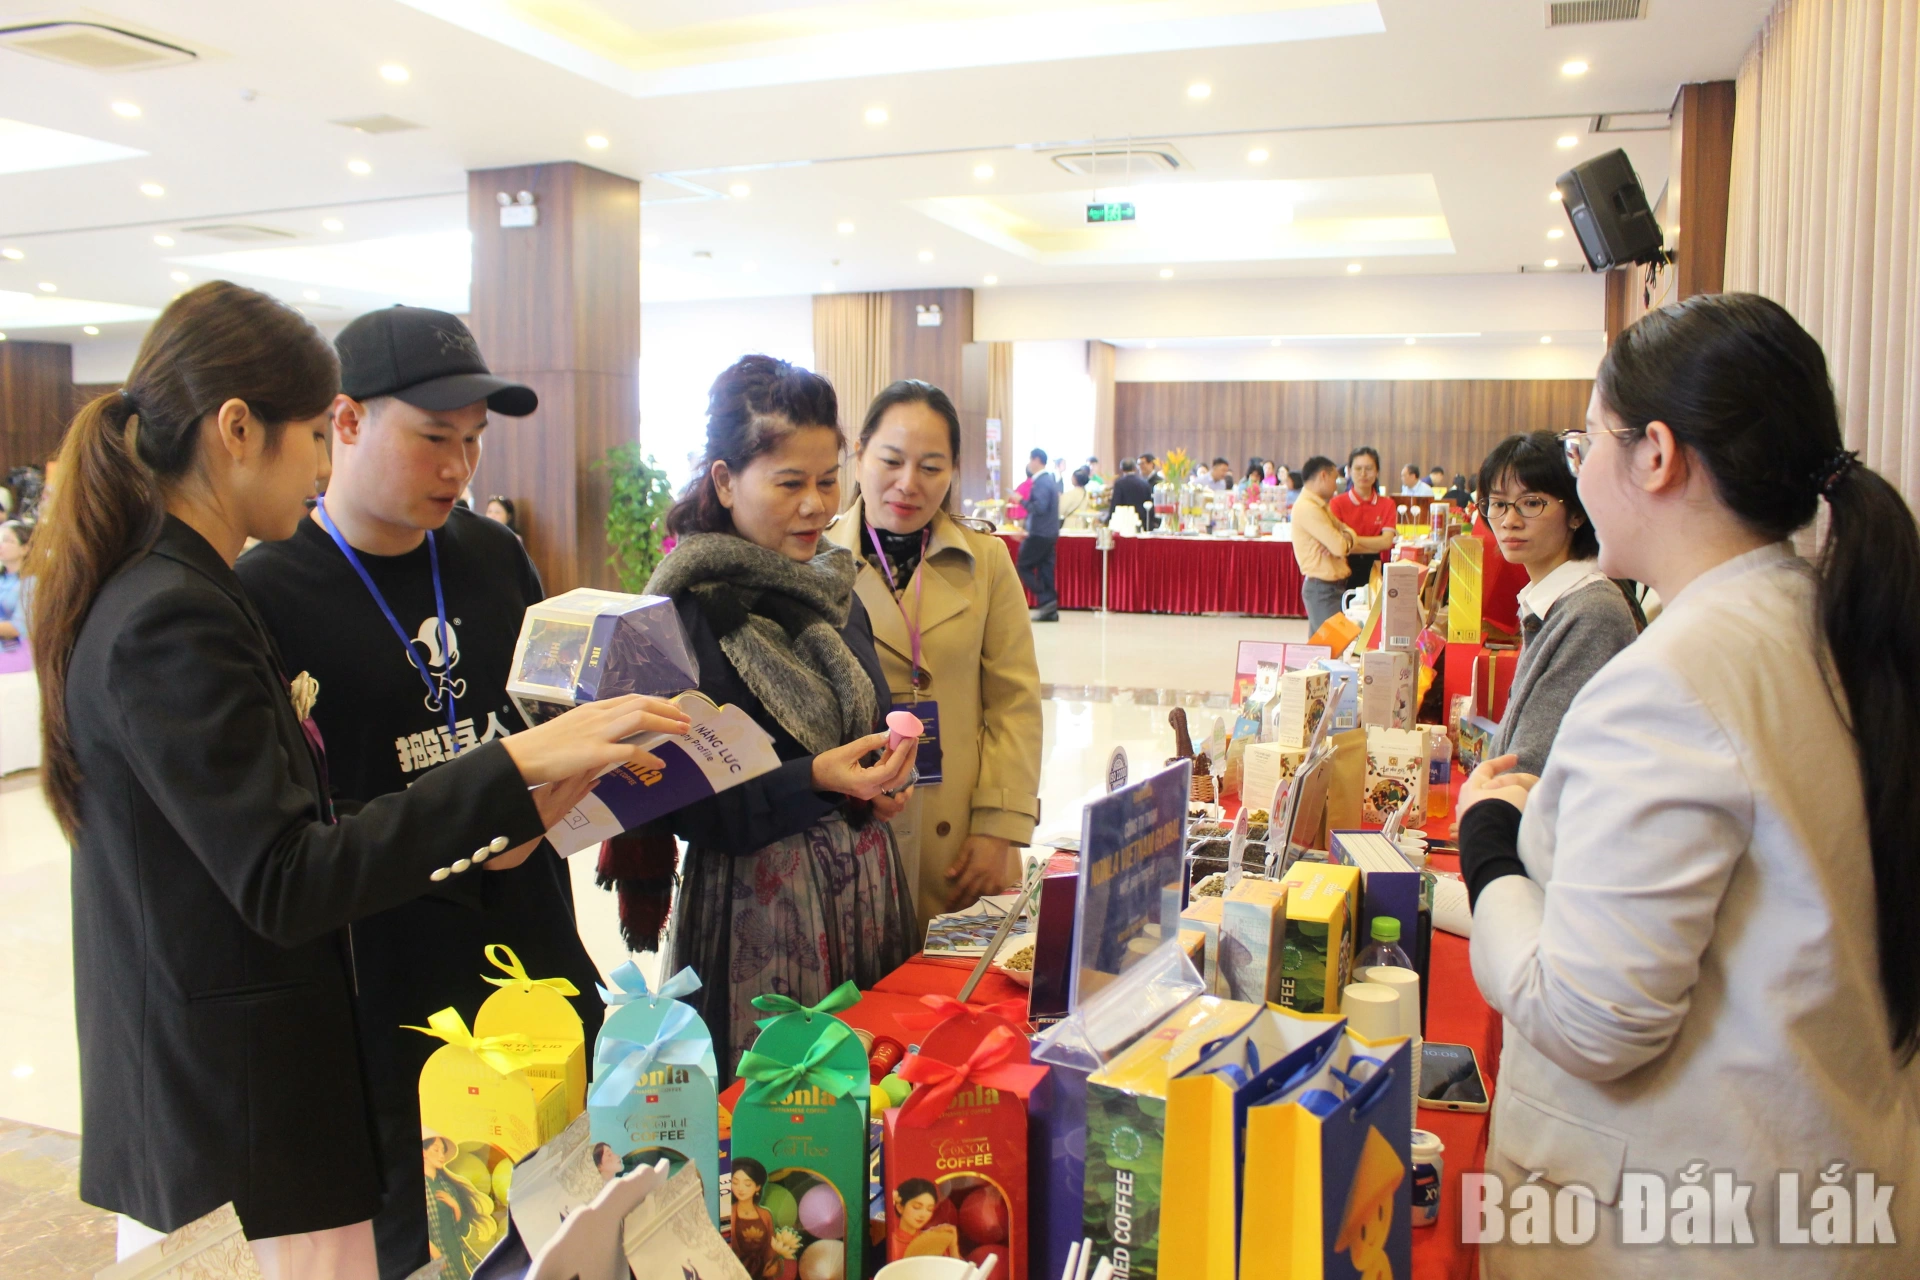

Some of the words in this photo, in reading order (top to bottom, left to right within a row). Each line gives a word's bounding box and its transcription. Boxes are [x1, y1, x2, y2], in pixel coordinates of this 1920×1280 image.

[691, 739, 714, 762] Profile
[718, 748, 742, 774] LỰC
[635, 1065, 690, 1087] onla
[769, 1085, 837, 1107] onla
[629, 1129, 686, 1143] COFFEE
[931, 1138, 991, 1157] Cocoa
[935, 1153, 993, 1170] COFFEE
[1115, 1169, 1134, 1244] COFFEE
